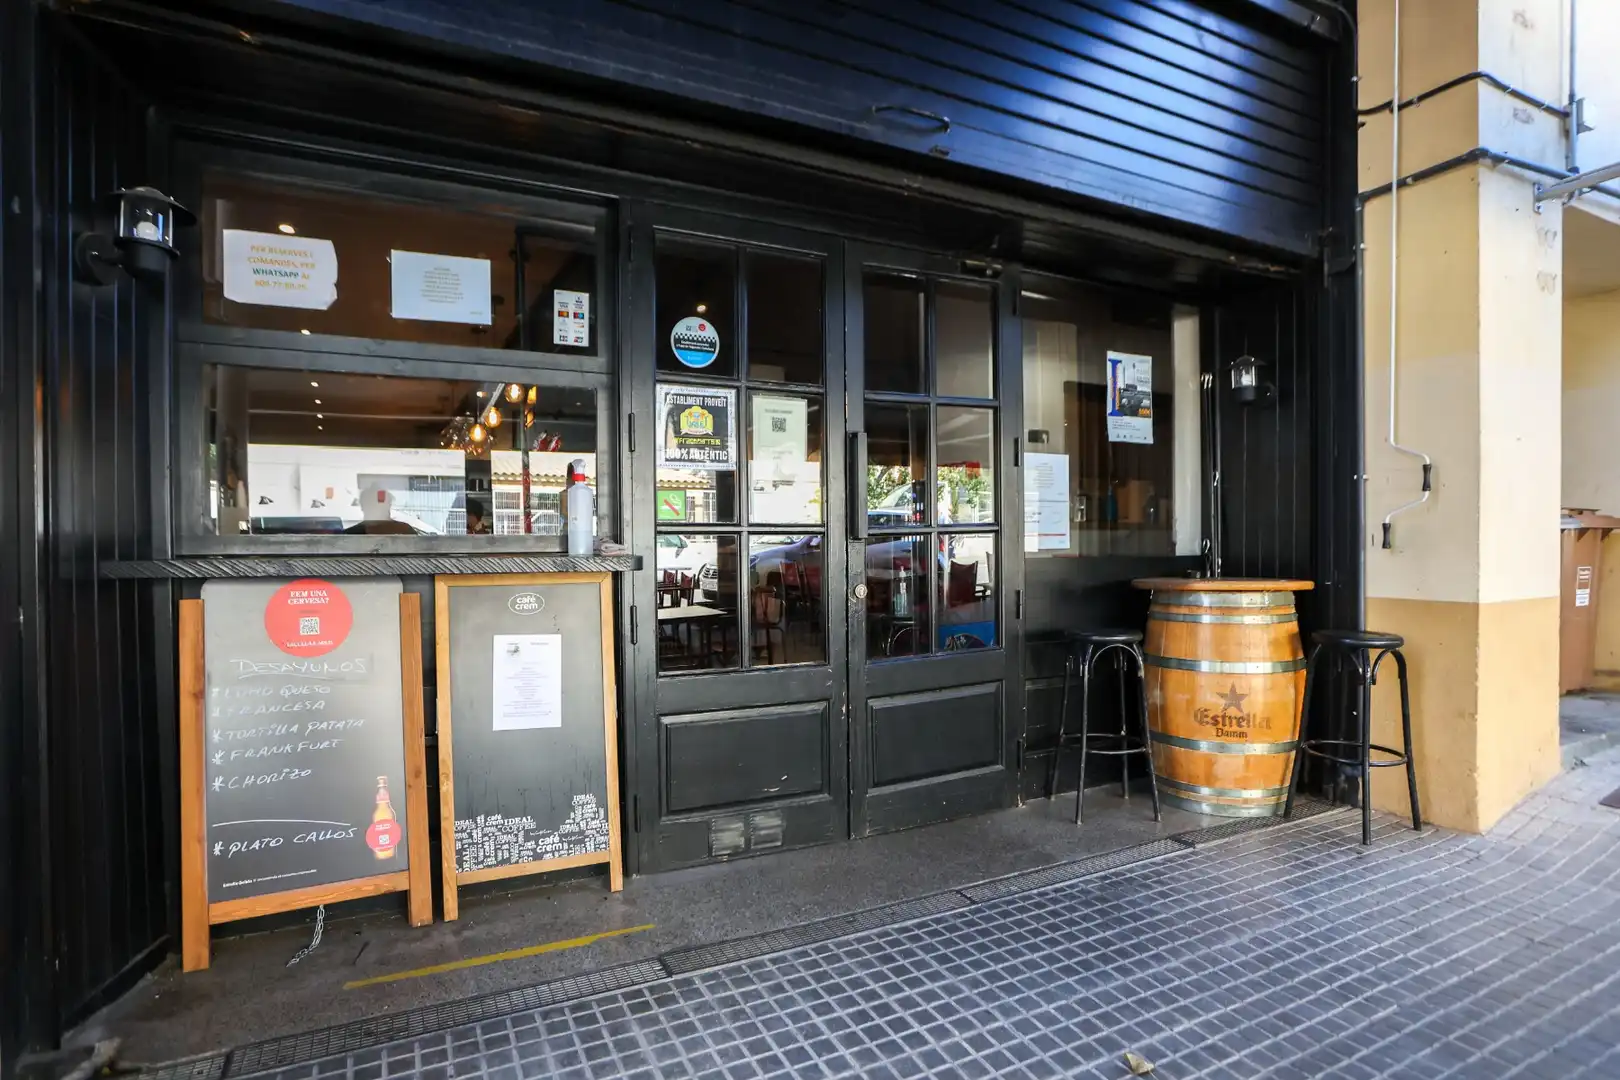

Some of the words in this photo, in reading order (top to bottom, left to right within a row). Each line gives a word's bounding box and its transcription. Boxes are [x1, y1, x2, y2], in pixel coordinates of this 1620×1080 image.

[252, 267, 299, 279] WHATSAPP
[666, 394, 703, 406] ESTABLIMENT
[665, 447, 688, 460] 100%
[688, 447, 728, 460] AUTÈNTIC
[309, 589, 327, 597] UNA
[287, 597, 330, 605] CERVESA?
[516, 595, 536, 604] café
[515, 602, 538, 610] crem
[229, 658, 367, 674] DESAYUNOS
[280, 684, 331, 698] QUESO
[1194, 706, 1272, 730] Estrella
[225, 724, 299, 740] TORTILLA
[305, 718, 366, 737] PATATA
[1215, 727, 1249, 739] Damm
[228, 768, 312, 789] CHORIZO
[573, 793, 595, 801] IDEAL
[487, 813, 502, 822] café
[504, 816, 534, 826] IDEAL
[501, 821, 537, 833] COFFEE
[228, 837, 284, 858] PLATO
[293, 827, 358, 844] CALLOS
[538, 831, 560, 845] café
[536, 842, 562, 853] crem
